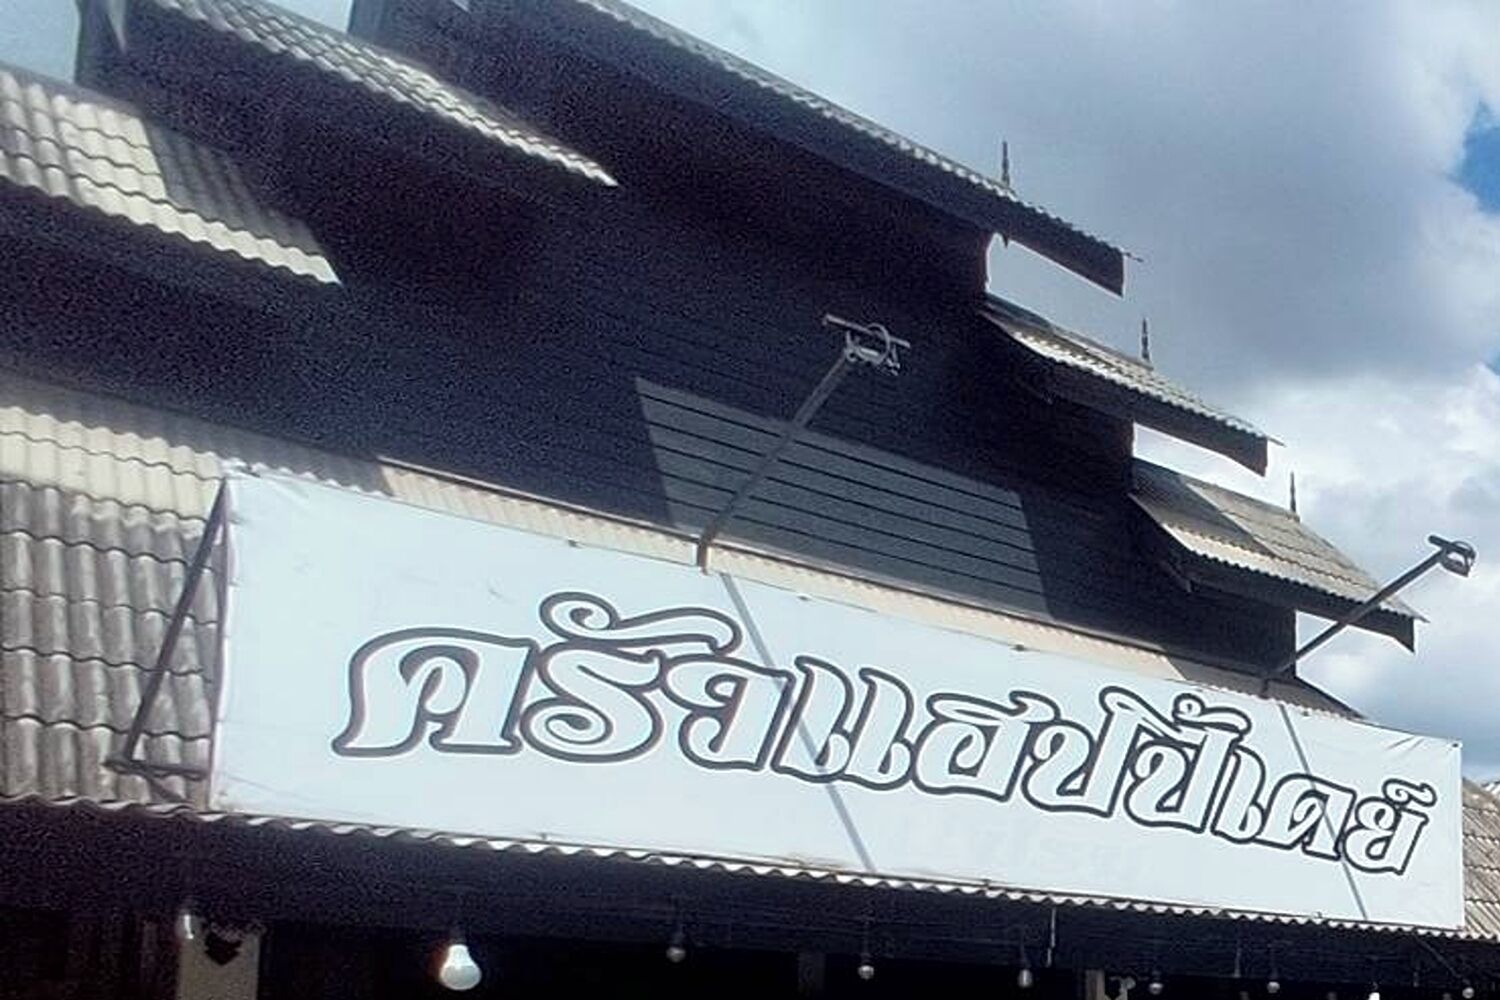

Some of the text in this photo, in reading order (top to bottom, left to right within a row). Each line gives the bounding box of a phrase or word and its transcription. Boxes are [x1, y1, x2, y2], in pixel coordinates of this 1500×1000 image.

[331, 591, 1437, 876] ครัวแฮปปี้เดย์
